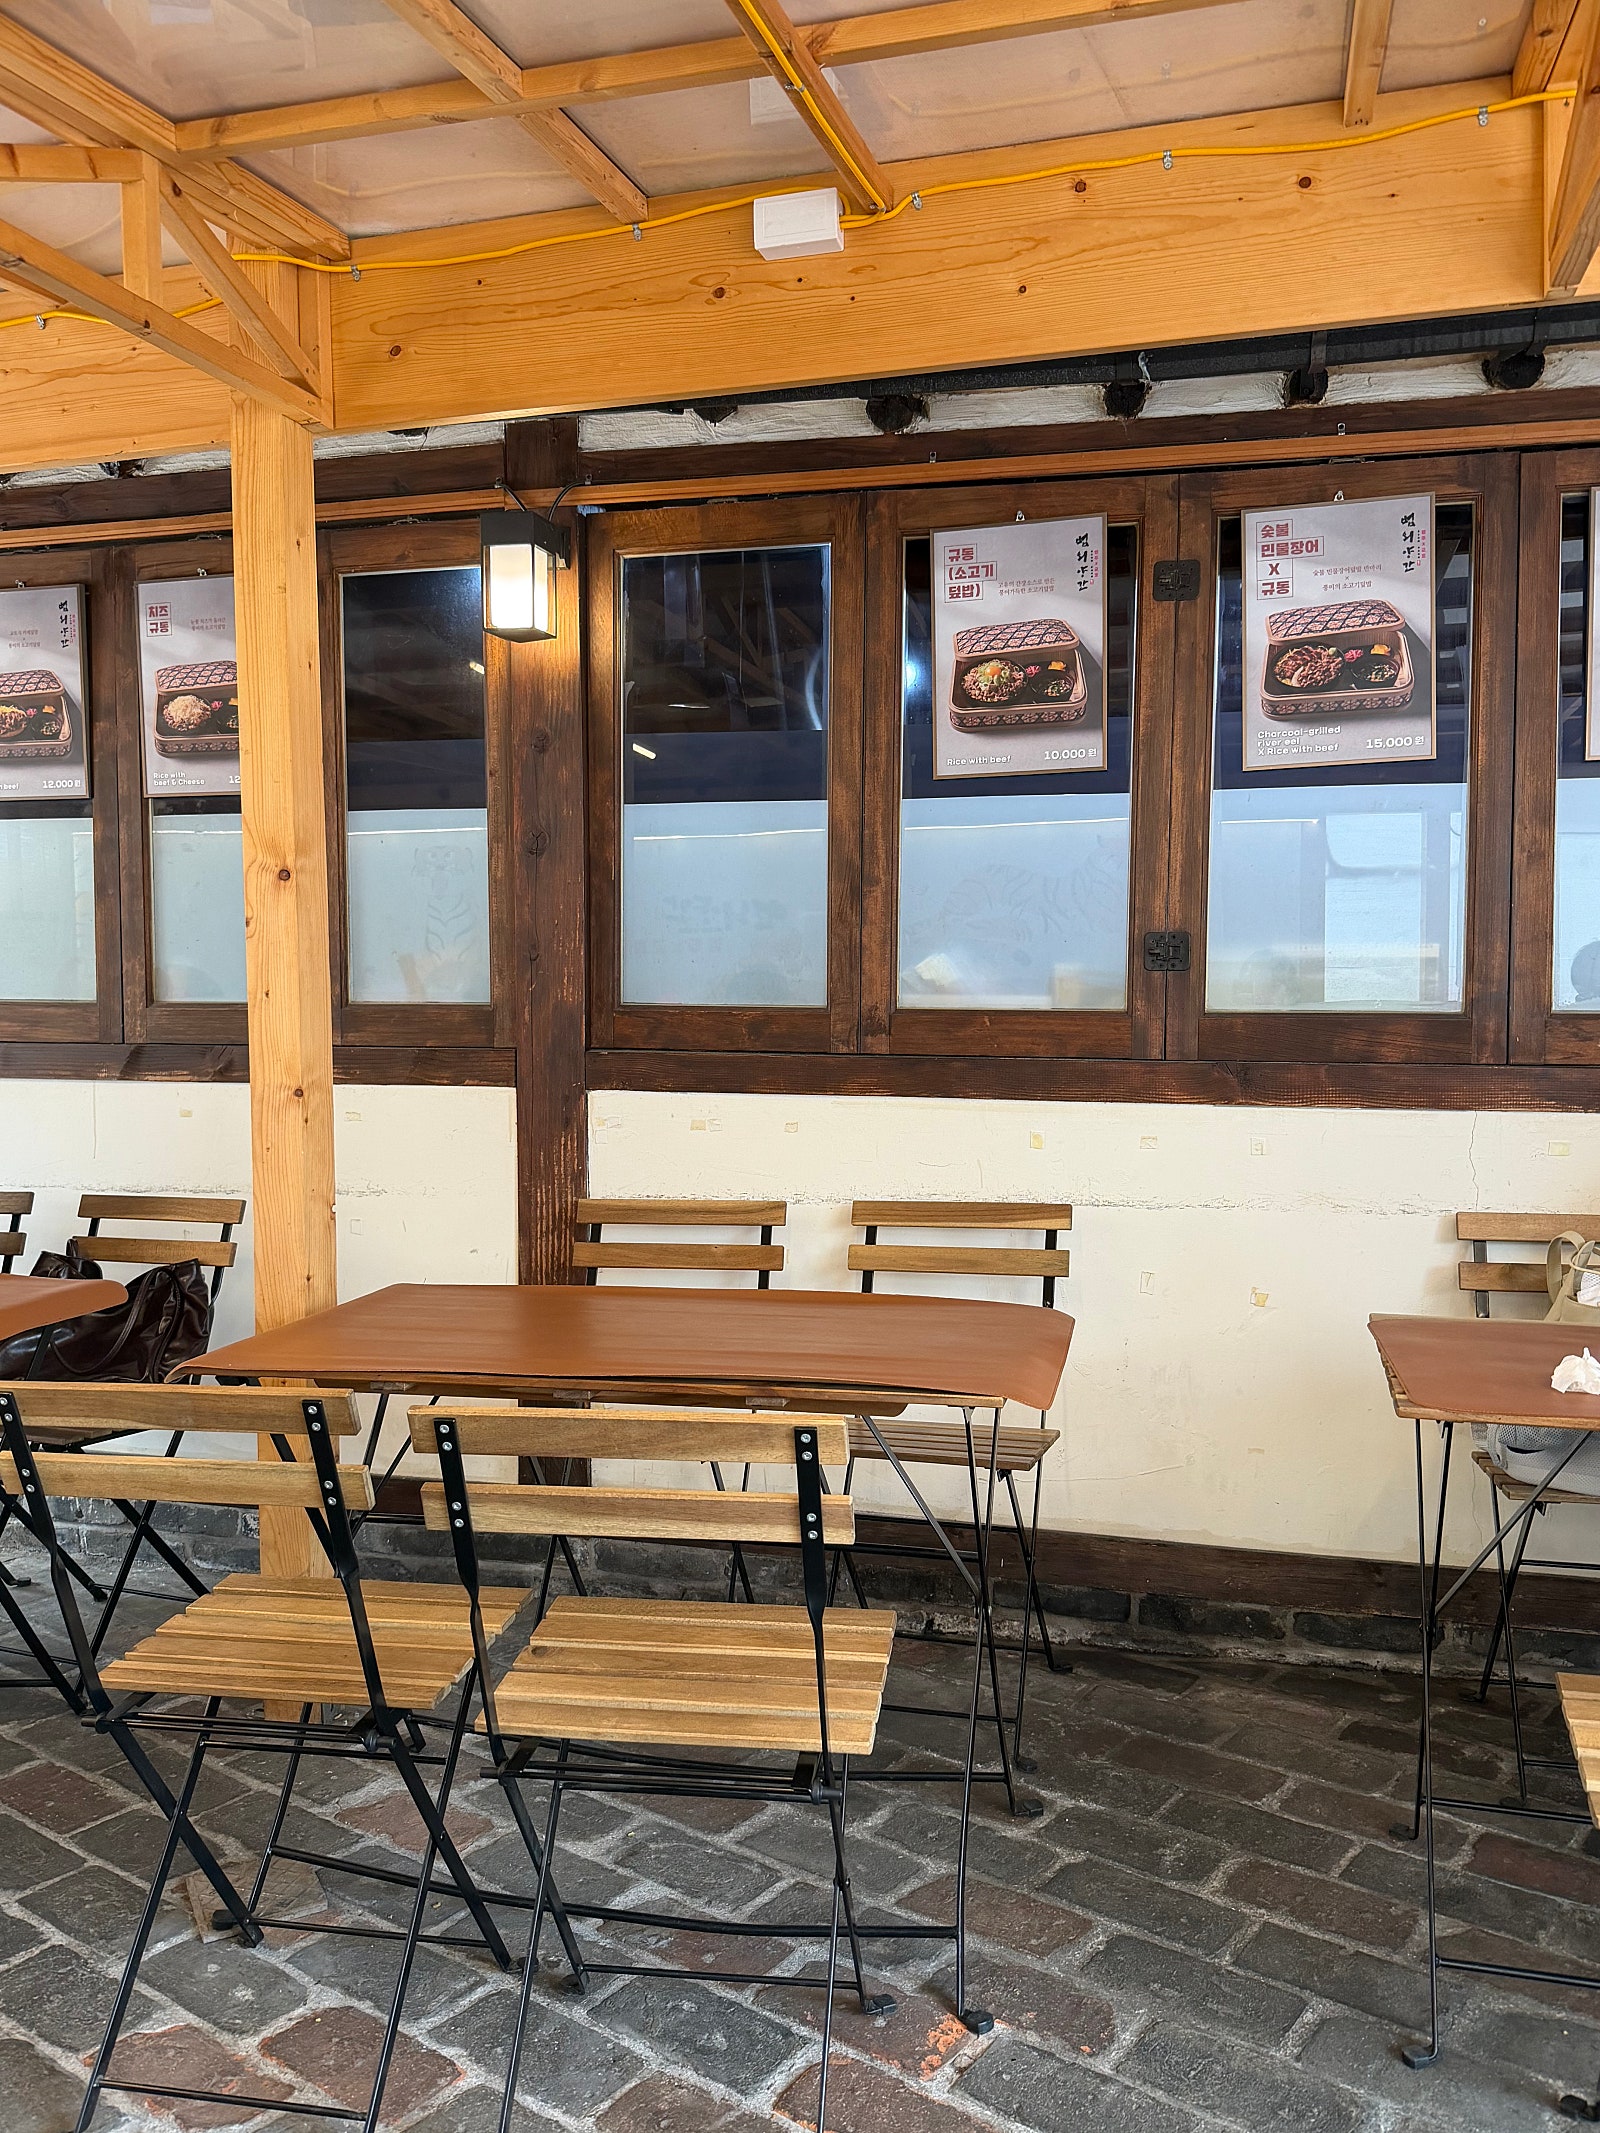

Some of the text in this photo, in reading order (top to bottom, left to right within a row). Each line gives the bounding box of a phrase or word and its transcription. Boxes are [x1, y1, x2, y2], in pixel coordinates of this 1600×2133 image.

[1261, 523, 1289, 538] 숯불
[948, 547, 974, 562] 규동
[1261, 539, 1319, 557] 민물장어
[948, 564, 994, 580] (소고기
[1268, 563, 1280, 576] X
[948, 583, 981, 599] 덮밥)
[1261, 580, 1290, 596] 규동
[148, 605, 168, 618] 치즈
[149, 621, 169, 634] 규동
[1257, 726, 1341, 738] Charcoal-grilled
[1257, 737, 1300, 747] river eel
[1366, 736, 1425, 749] 15,000 원
[1044, 748, 1097, 761] 10,000 원
[1267, 747, 1289, 755] Rice
[1291, 745, 1313, 754] with
[1315, 743, 1339, 752] beef
[947, 755, 1011, 766] Rice with beef
